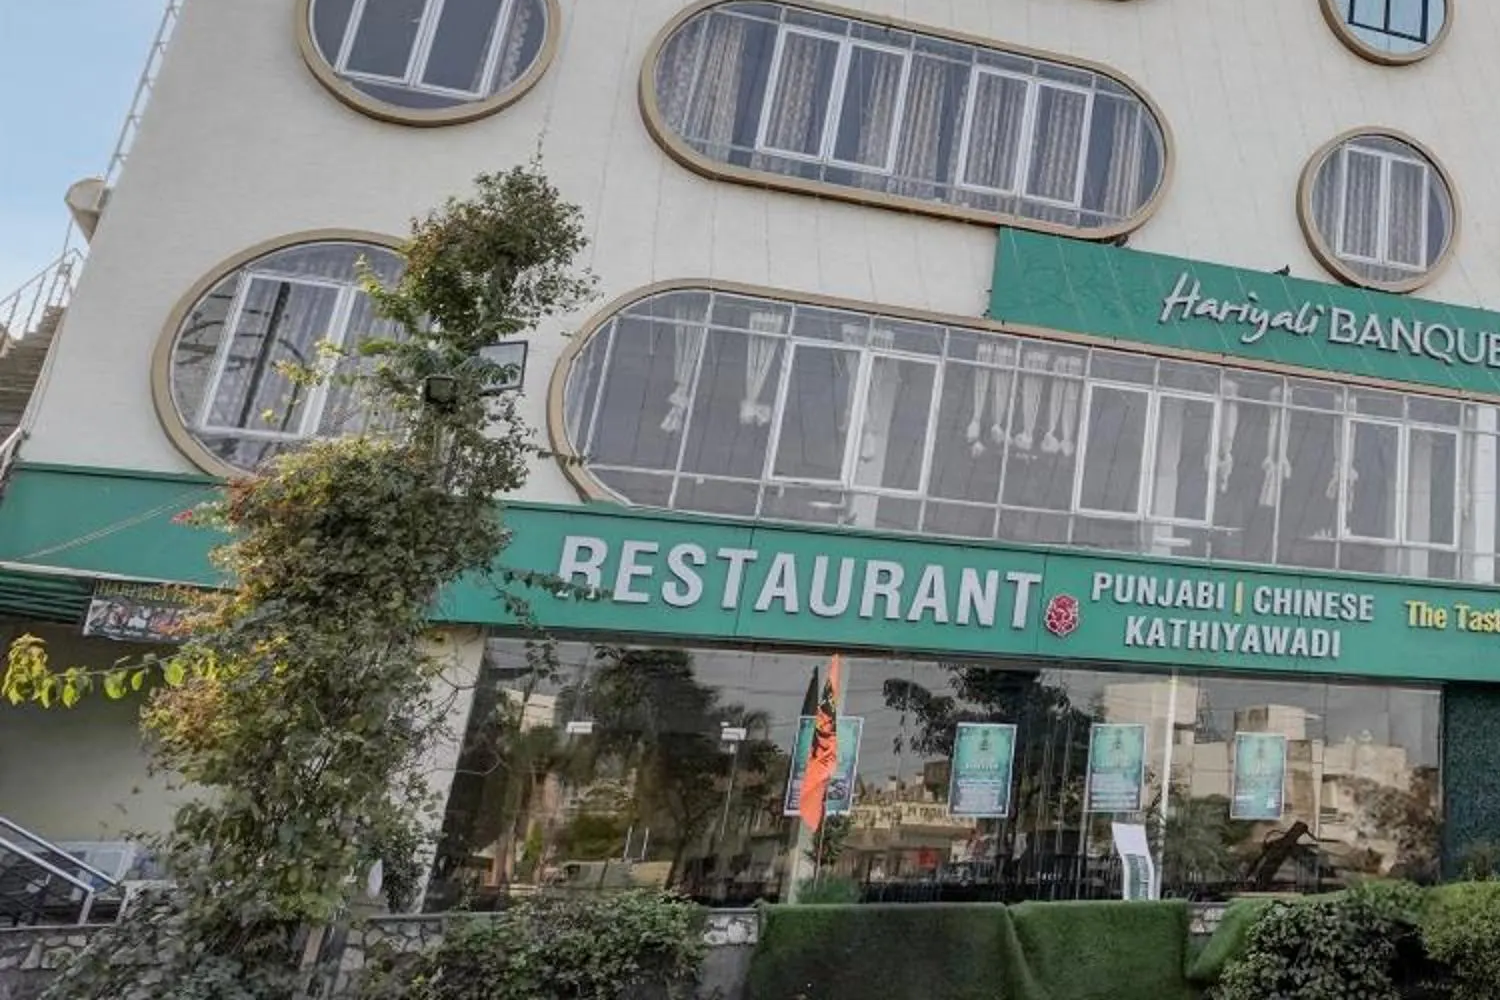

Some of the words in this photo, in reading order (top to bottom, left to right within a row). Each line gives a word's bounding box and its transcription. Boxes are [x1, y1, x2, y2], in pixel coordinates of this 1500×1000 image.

[1158, 272, 1326, 344] Hariyali
[557, 535, 1043, 630] RESTAURANT
[1091, 572, 1226, 610] PUNJABI
[1253, 585, 1375, 622] CHINESE
[1125, 615, 1341, 658] KATHIYAWADI
[1407, 600, 1448, 629] The
